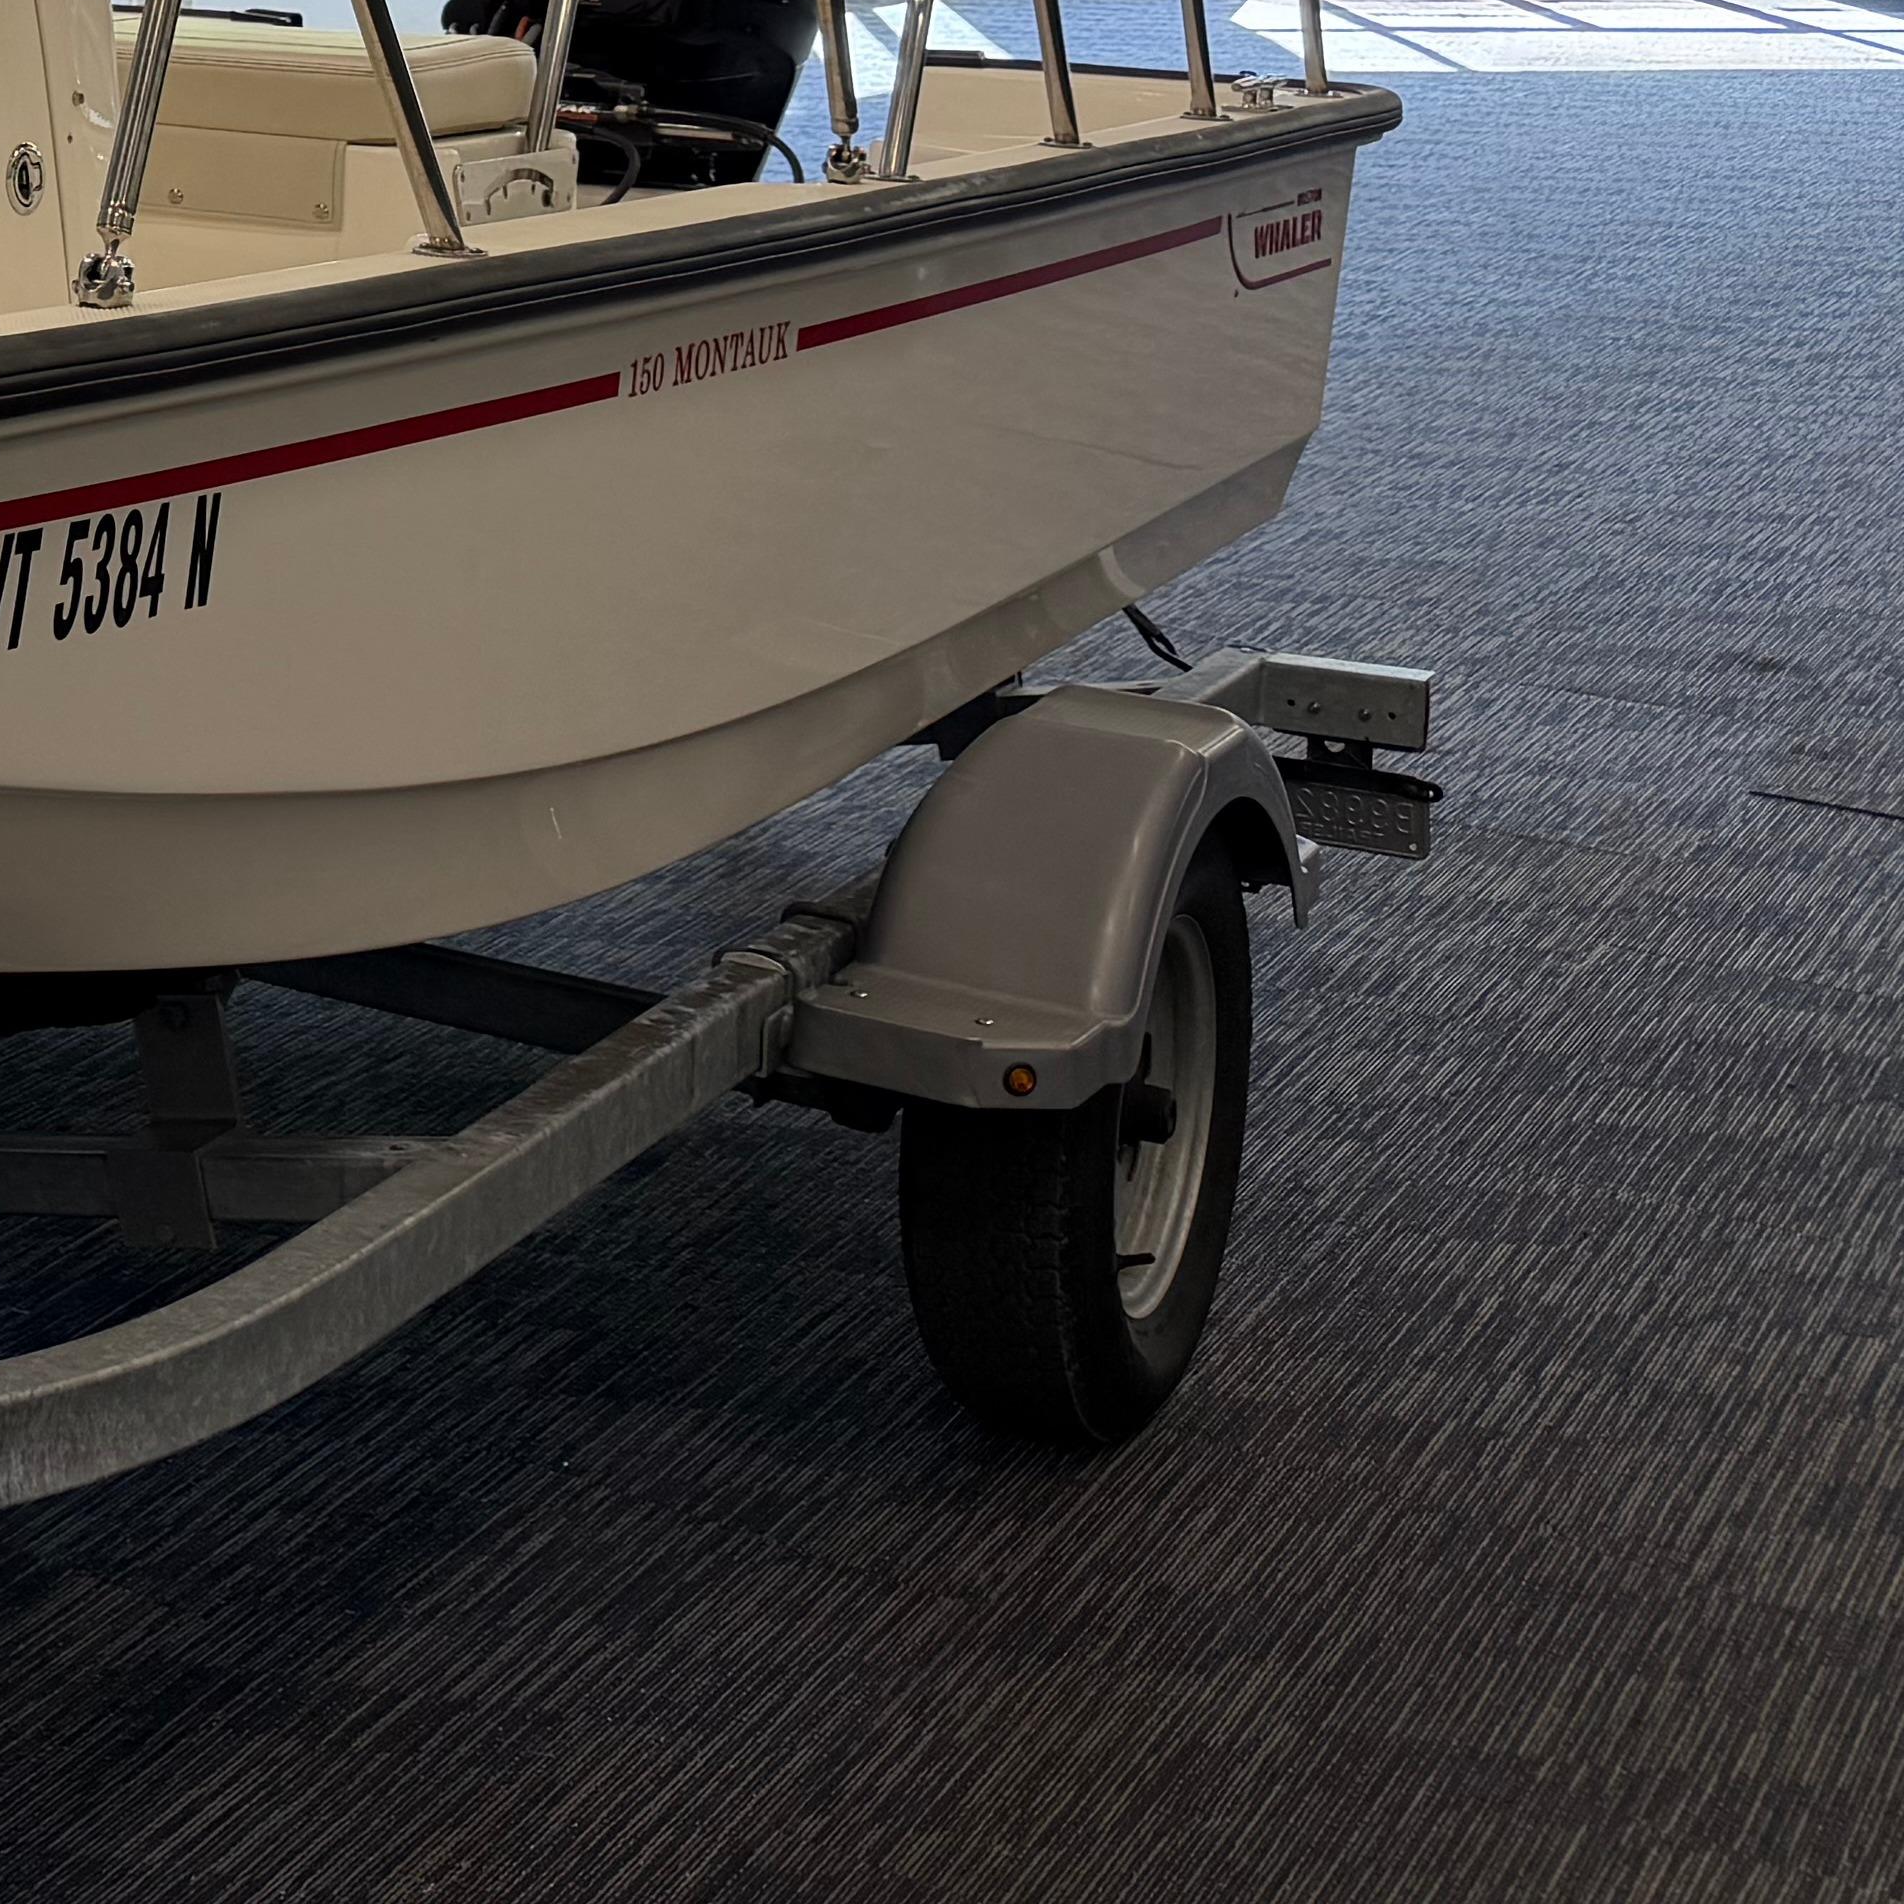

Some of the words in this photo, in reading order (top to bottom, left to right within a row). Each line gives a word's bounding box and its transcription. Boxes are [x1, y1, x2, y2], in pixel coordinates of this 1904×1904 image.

[1255, 210, 1323, 259] WHALER
[627, 351, 665, 398] 150
[673, 321, 793, 387] MONTAUK
[53, 501, 171, 642] 5384
[184, 492, 223, 610] N
